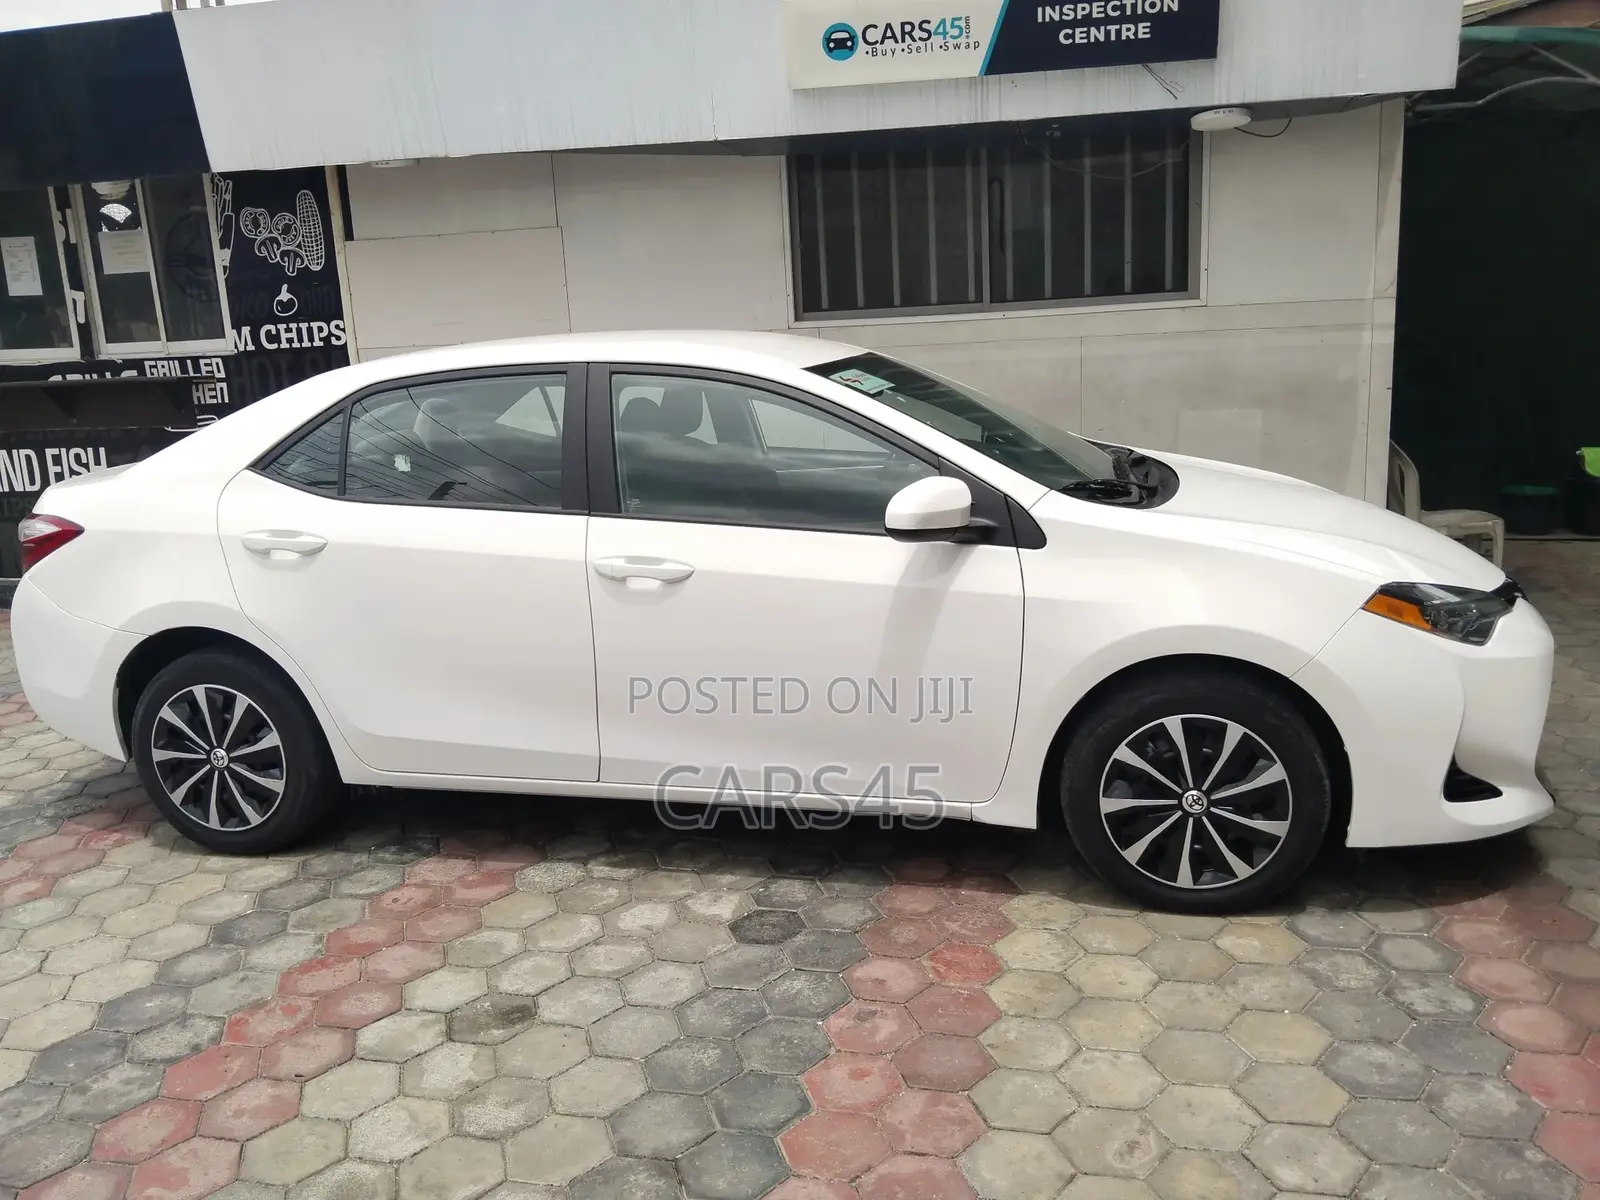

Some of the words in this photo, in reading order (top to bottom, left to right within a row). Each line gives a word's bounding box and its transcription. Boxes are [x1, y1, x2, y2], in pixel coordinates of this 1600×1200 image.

[1037, 0, 1179, 23] INSPECTION
[861, 16, 964, 46] CARS45
[1058, 22, 1151, 45] CENTRE
[260, 320, 347, 350] CHIPS
[0, 448, 41, 492] ND
